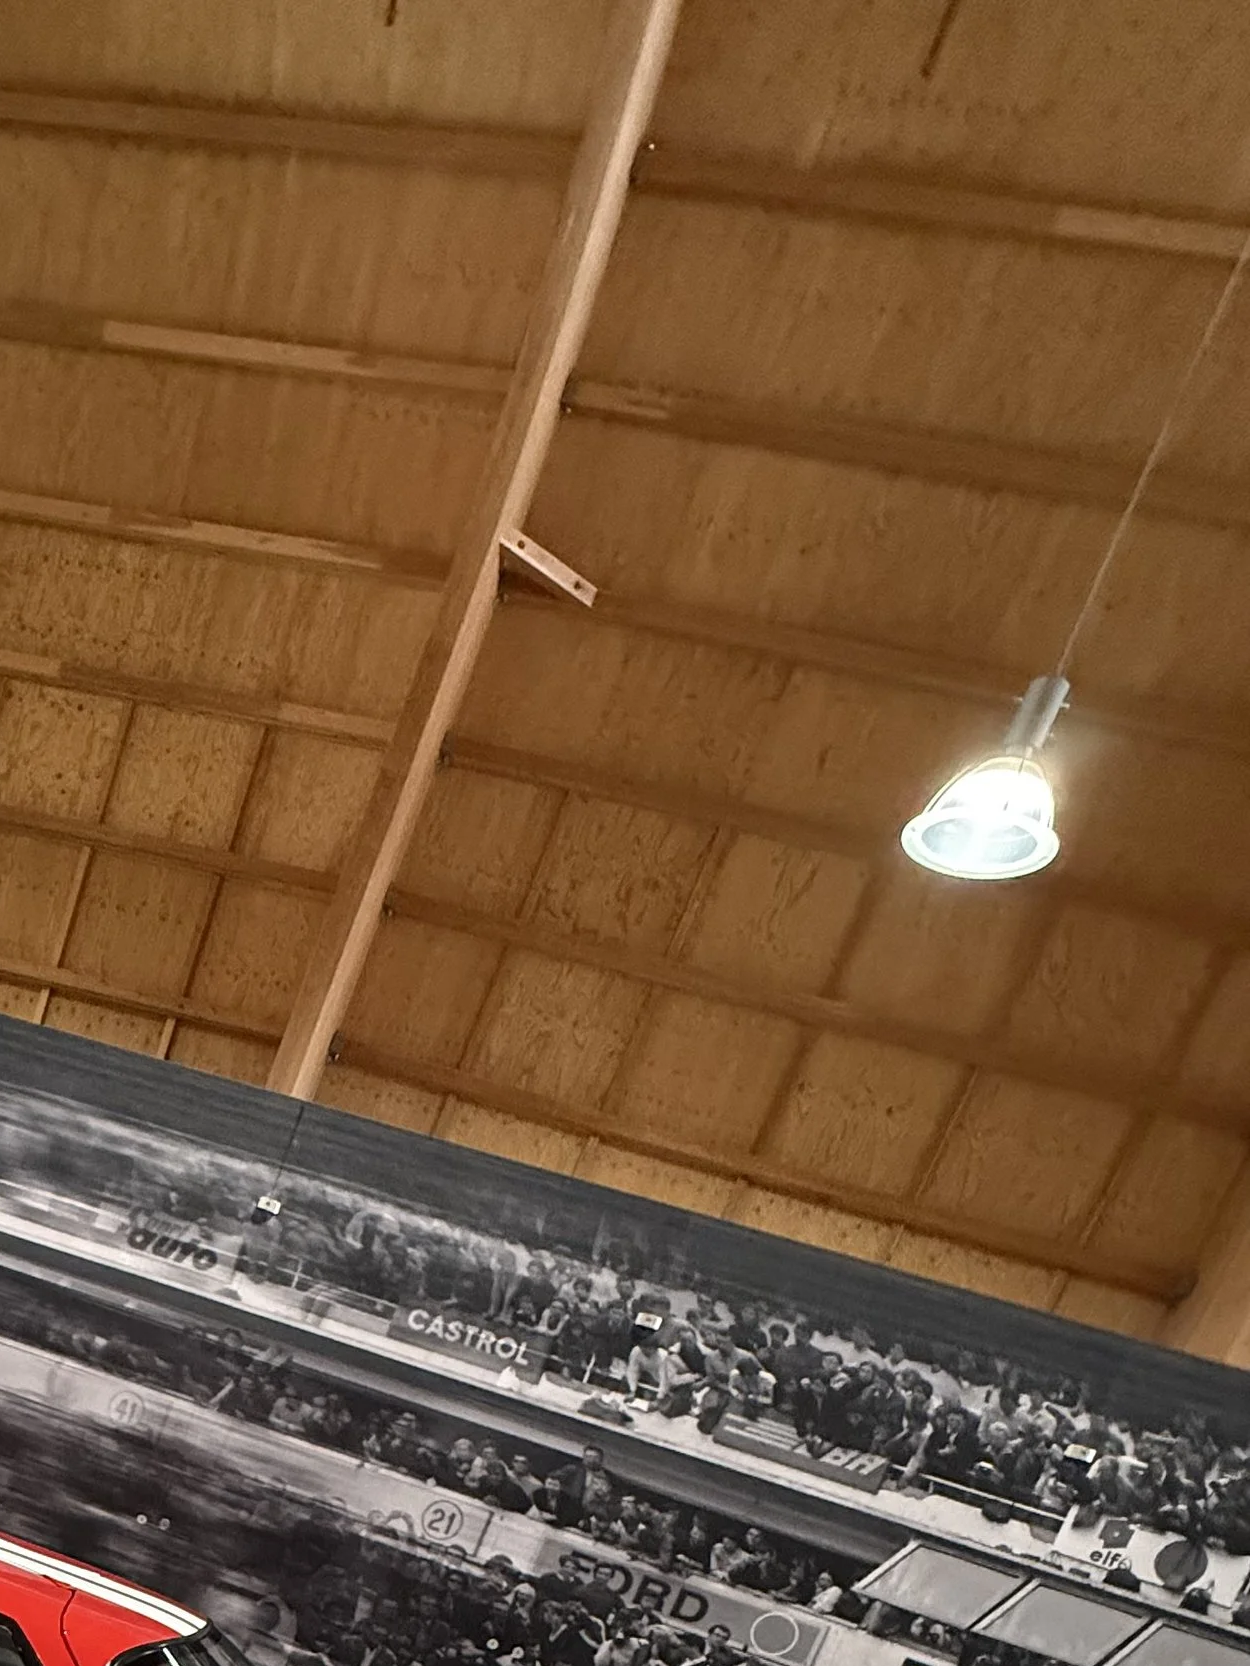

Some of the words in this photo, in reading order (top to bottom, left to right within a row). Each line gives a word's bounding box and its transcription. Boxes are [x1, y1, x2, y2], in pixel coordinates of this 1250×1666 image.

[408, 1309, 528, 1365] CASTROL
[427, 1507, 457, 1533] 21
[1090, 1551, 1121, 1567] elf
